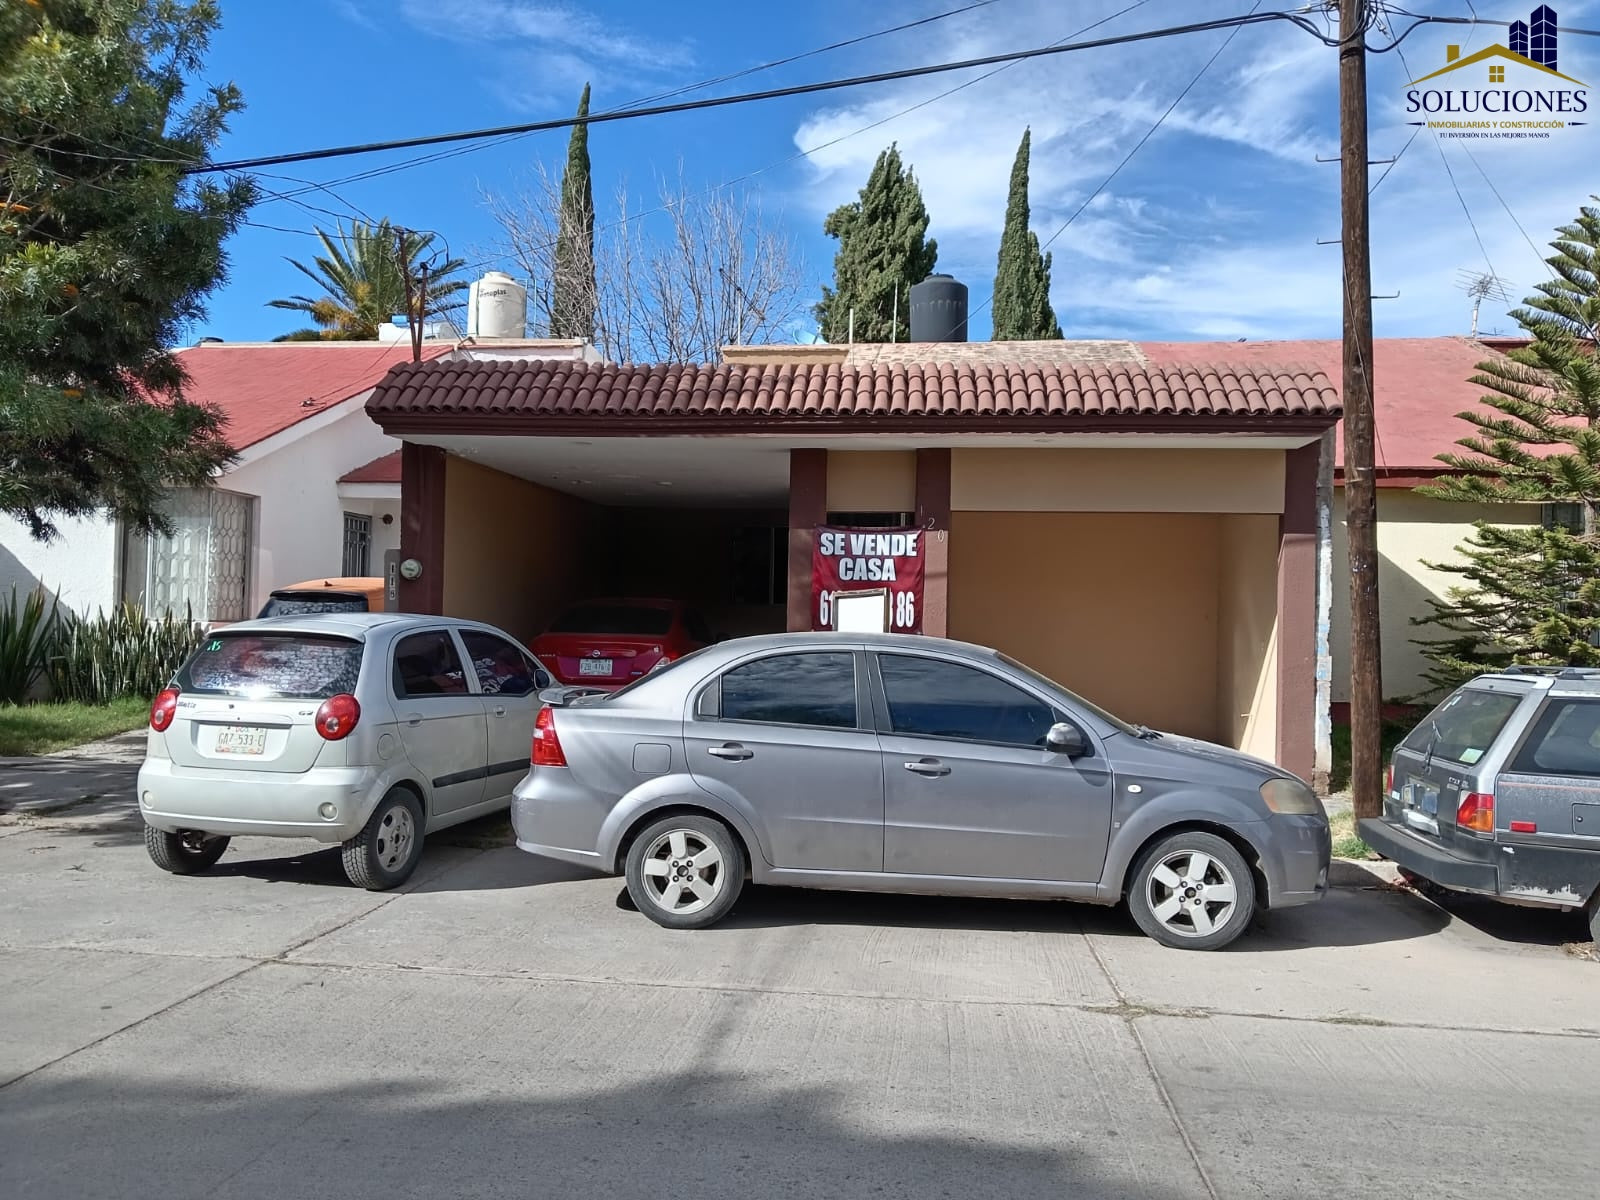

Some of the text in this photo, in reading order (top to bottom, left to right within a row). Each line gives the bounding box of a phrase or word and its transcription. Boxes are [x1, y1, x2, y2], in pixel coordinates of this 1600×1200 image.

[820, 532, 918, 557] SE VENDE
[839, 557, 897, 581] CASA
[896, 591, 915, 628] 86
